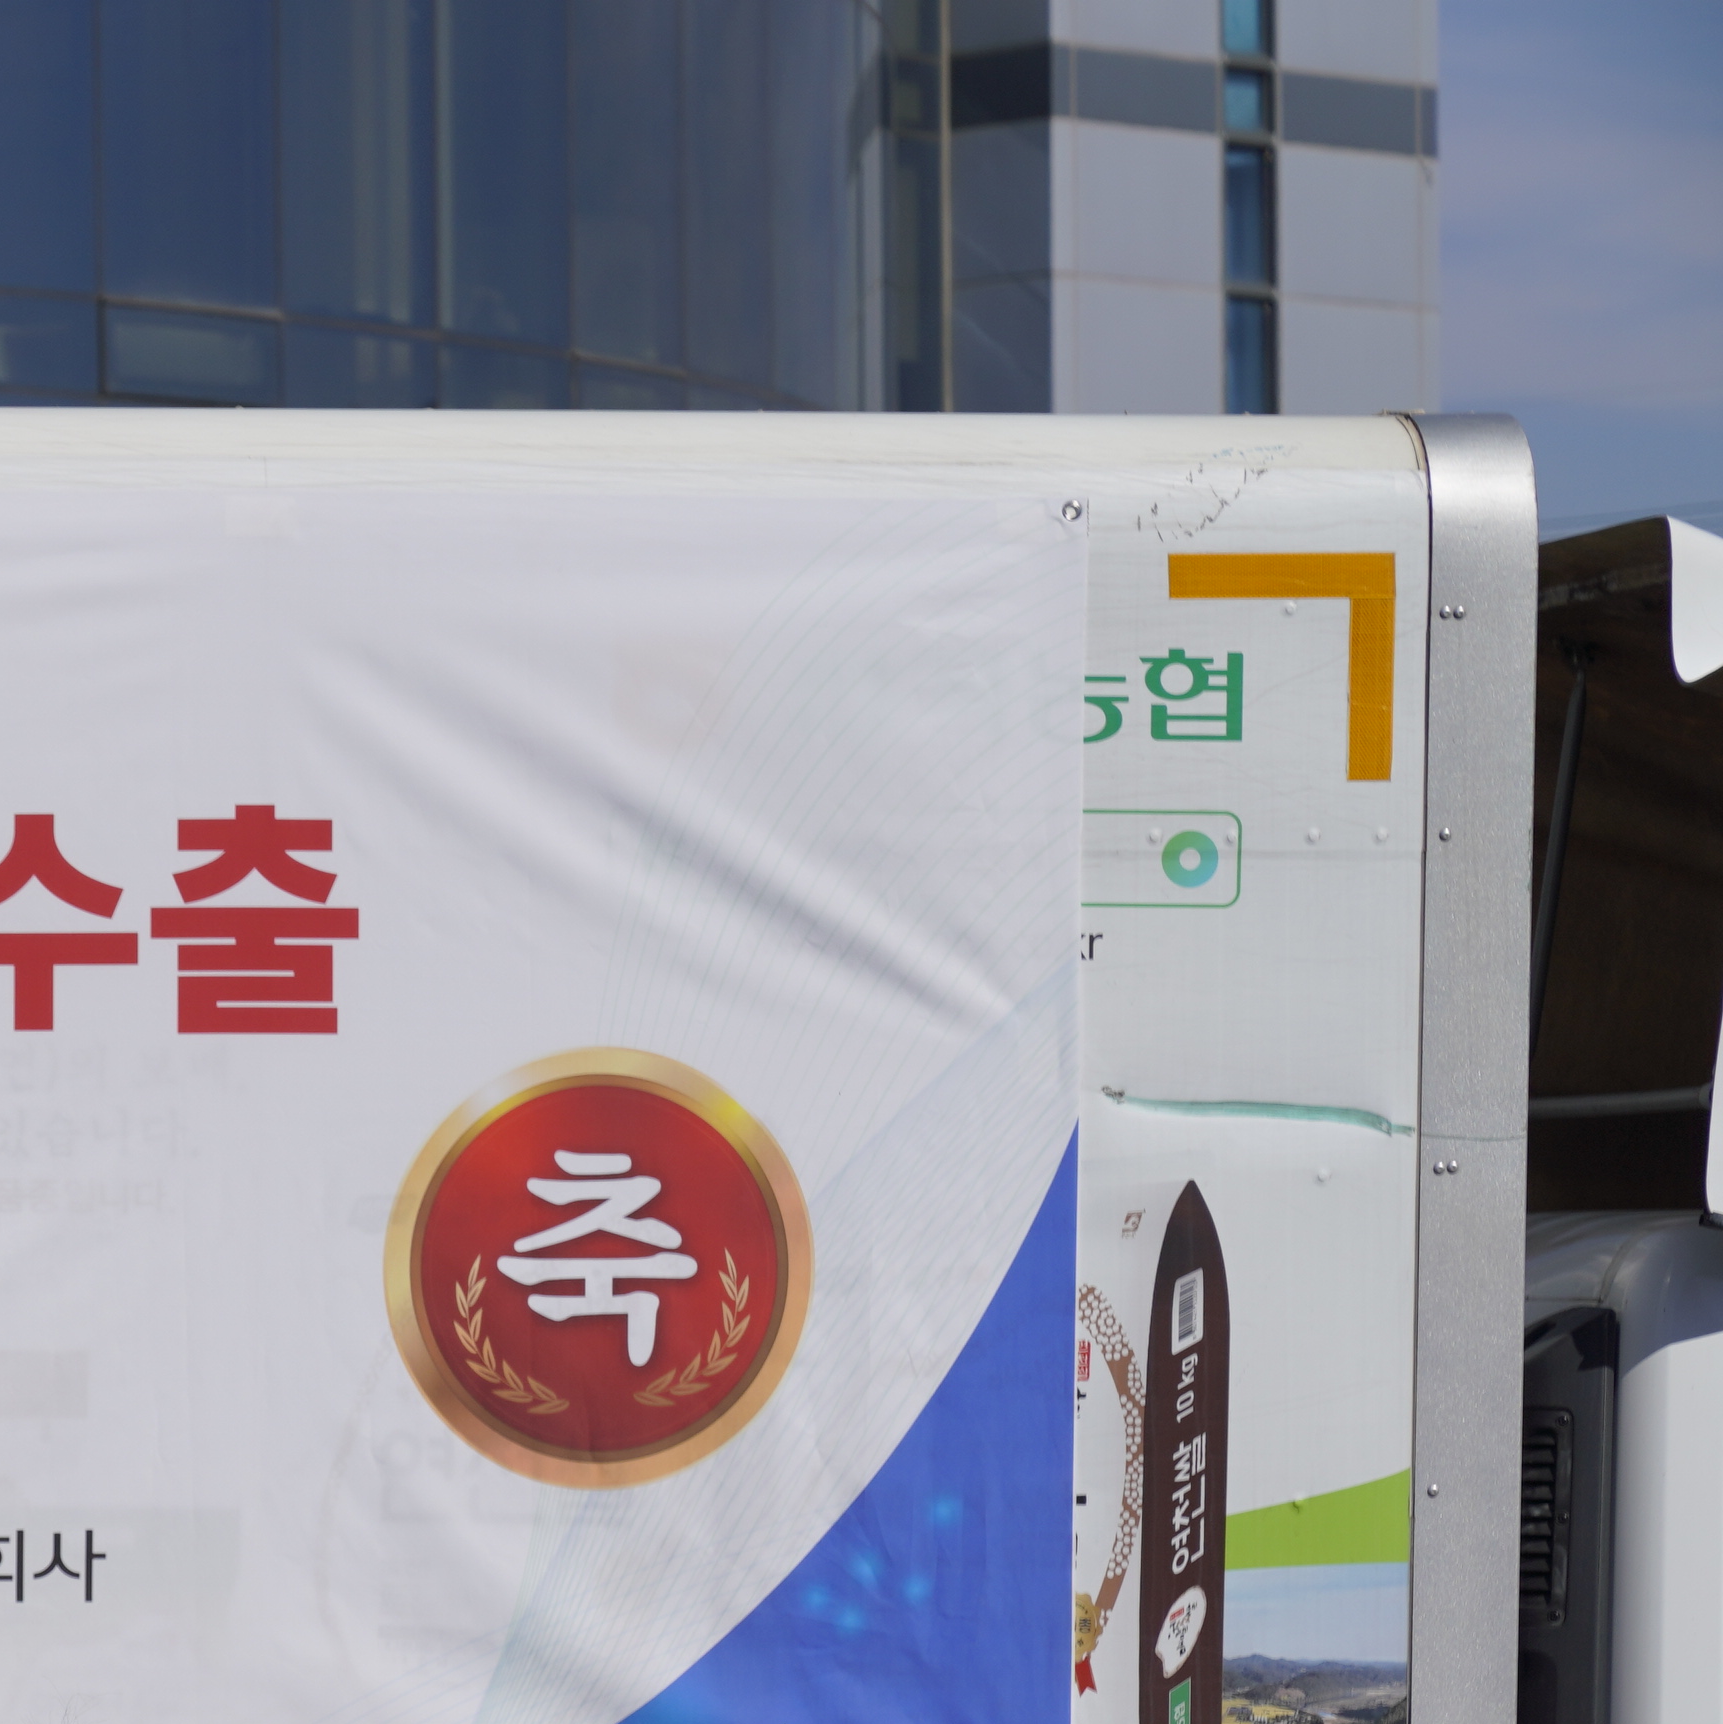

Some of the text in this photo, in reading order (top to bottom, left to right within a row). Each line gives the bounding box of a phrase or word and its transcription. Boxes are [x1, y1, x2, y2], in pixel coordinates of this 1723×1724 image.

[497, 1148, 699, 1370] 축
[1176, 1352, 1198, 1423] 10 kg
[1172, 1432, 1206, 1574] 연천쌀
